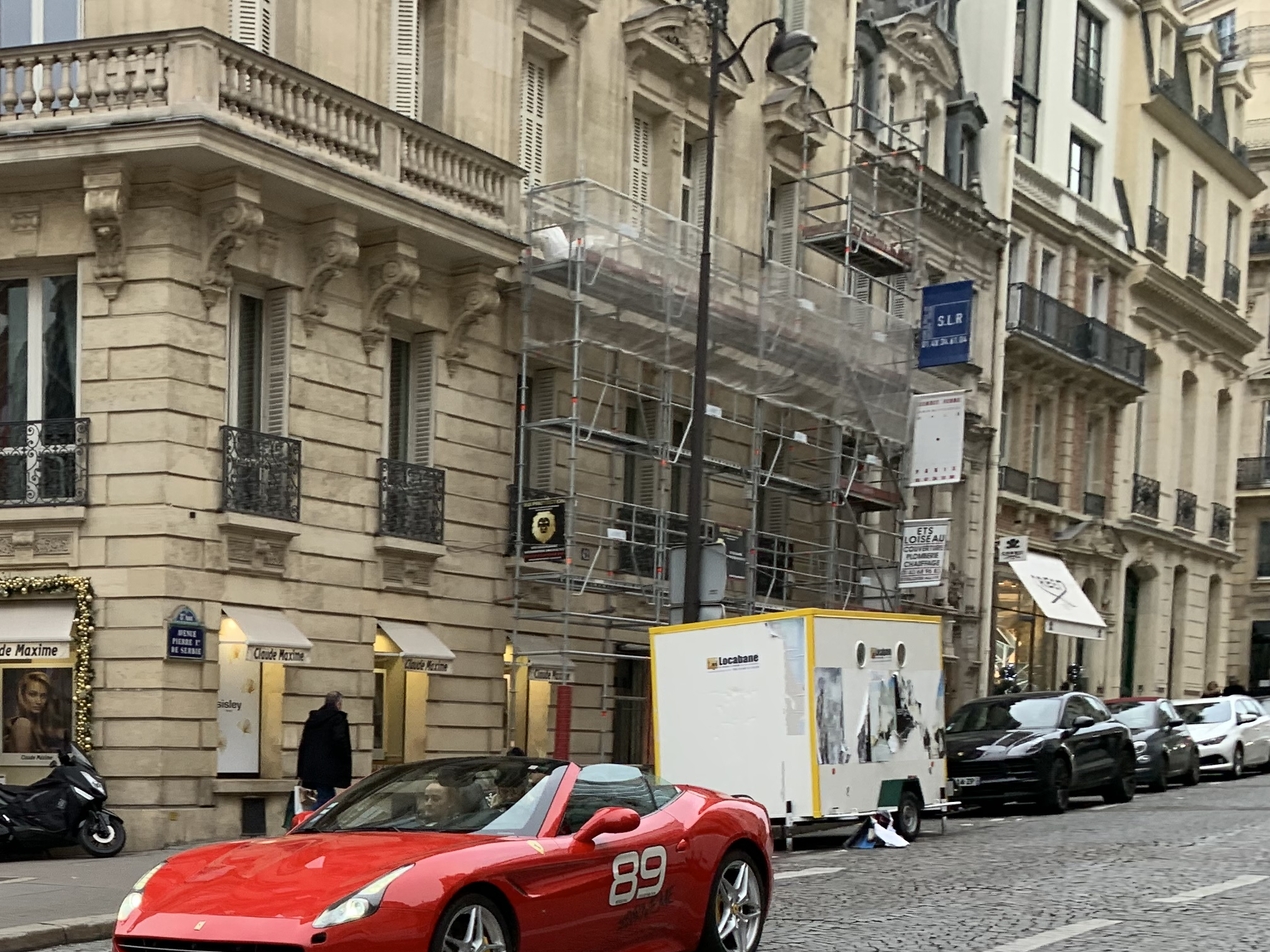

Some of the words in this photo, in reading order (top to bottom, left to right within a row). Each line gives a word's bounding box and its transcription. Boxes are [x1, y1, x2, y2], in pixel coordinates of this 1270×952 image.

[917, 527, 934, 535] ETS
[904, 534, 945, 544] LOISEAU
[172, 638, 193, 646] PIERRE
[15, 644, 58, 657] Maxime
[254, 648, 277, 660] Claude
[279, 649, 305, 661] Maxime
[405, 659, 425, 671] Claude
[425, 660, 448, 672] Maxime
[718, 654, 759, 666] Locabane
[609, 845, 667, 906] 89
